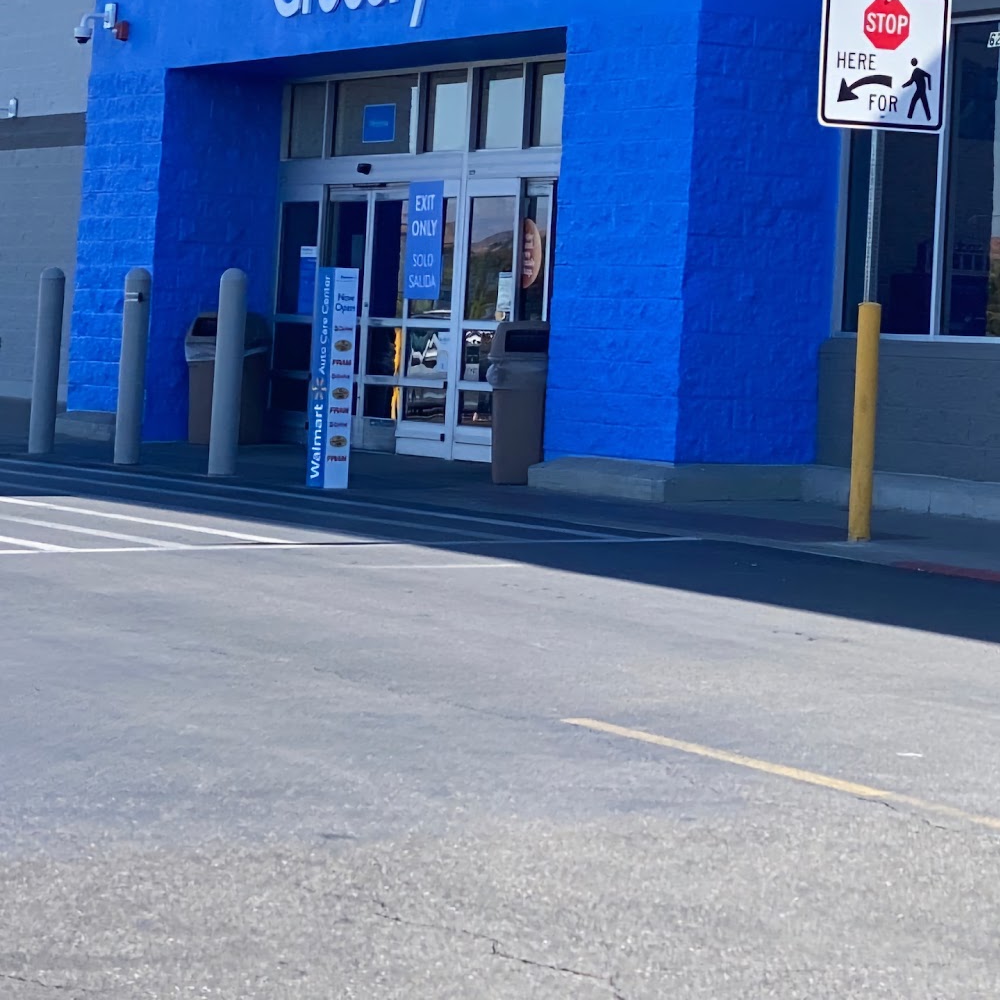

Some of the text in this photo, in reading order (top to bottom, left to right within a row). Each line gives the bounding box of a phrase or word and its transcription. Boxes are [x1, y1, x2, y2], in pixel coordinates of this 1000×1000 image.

[865, 12, 909, 35] STOP
[836, 51, 877, 70] HERE
[868, 94, 898, 112] FOR
[415, 194, 436, 212] EXIT
[412, 219, 438, 236] ONLY
[412, 253, 434, 267] SOLO
[408, 274, 436, 288] SALIDA
[320, 318, 329, 345] Care
[318, 346, 327, 375] Auto
[310, 403, 323, 479] Walmart
